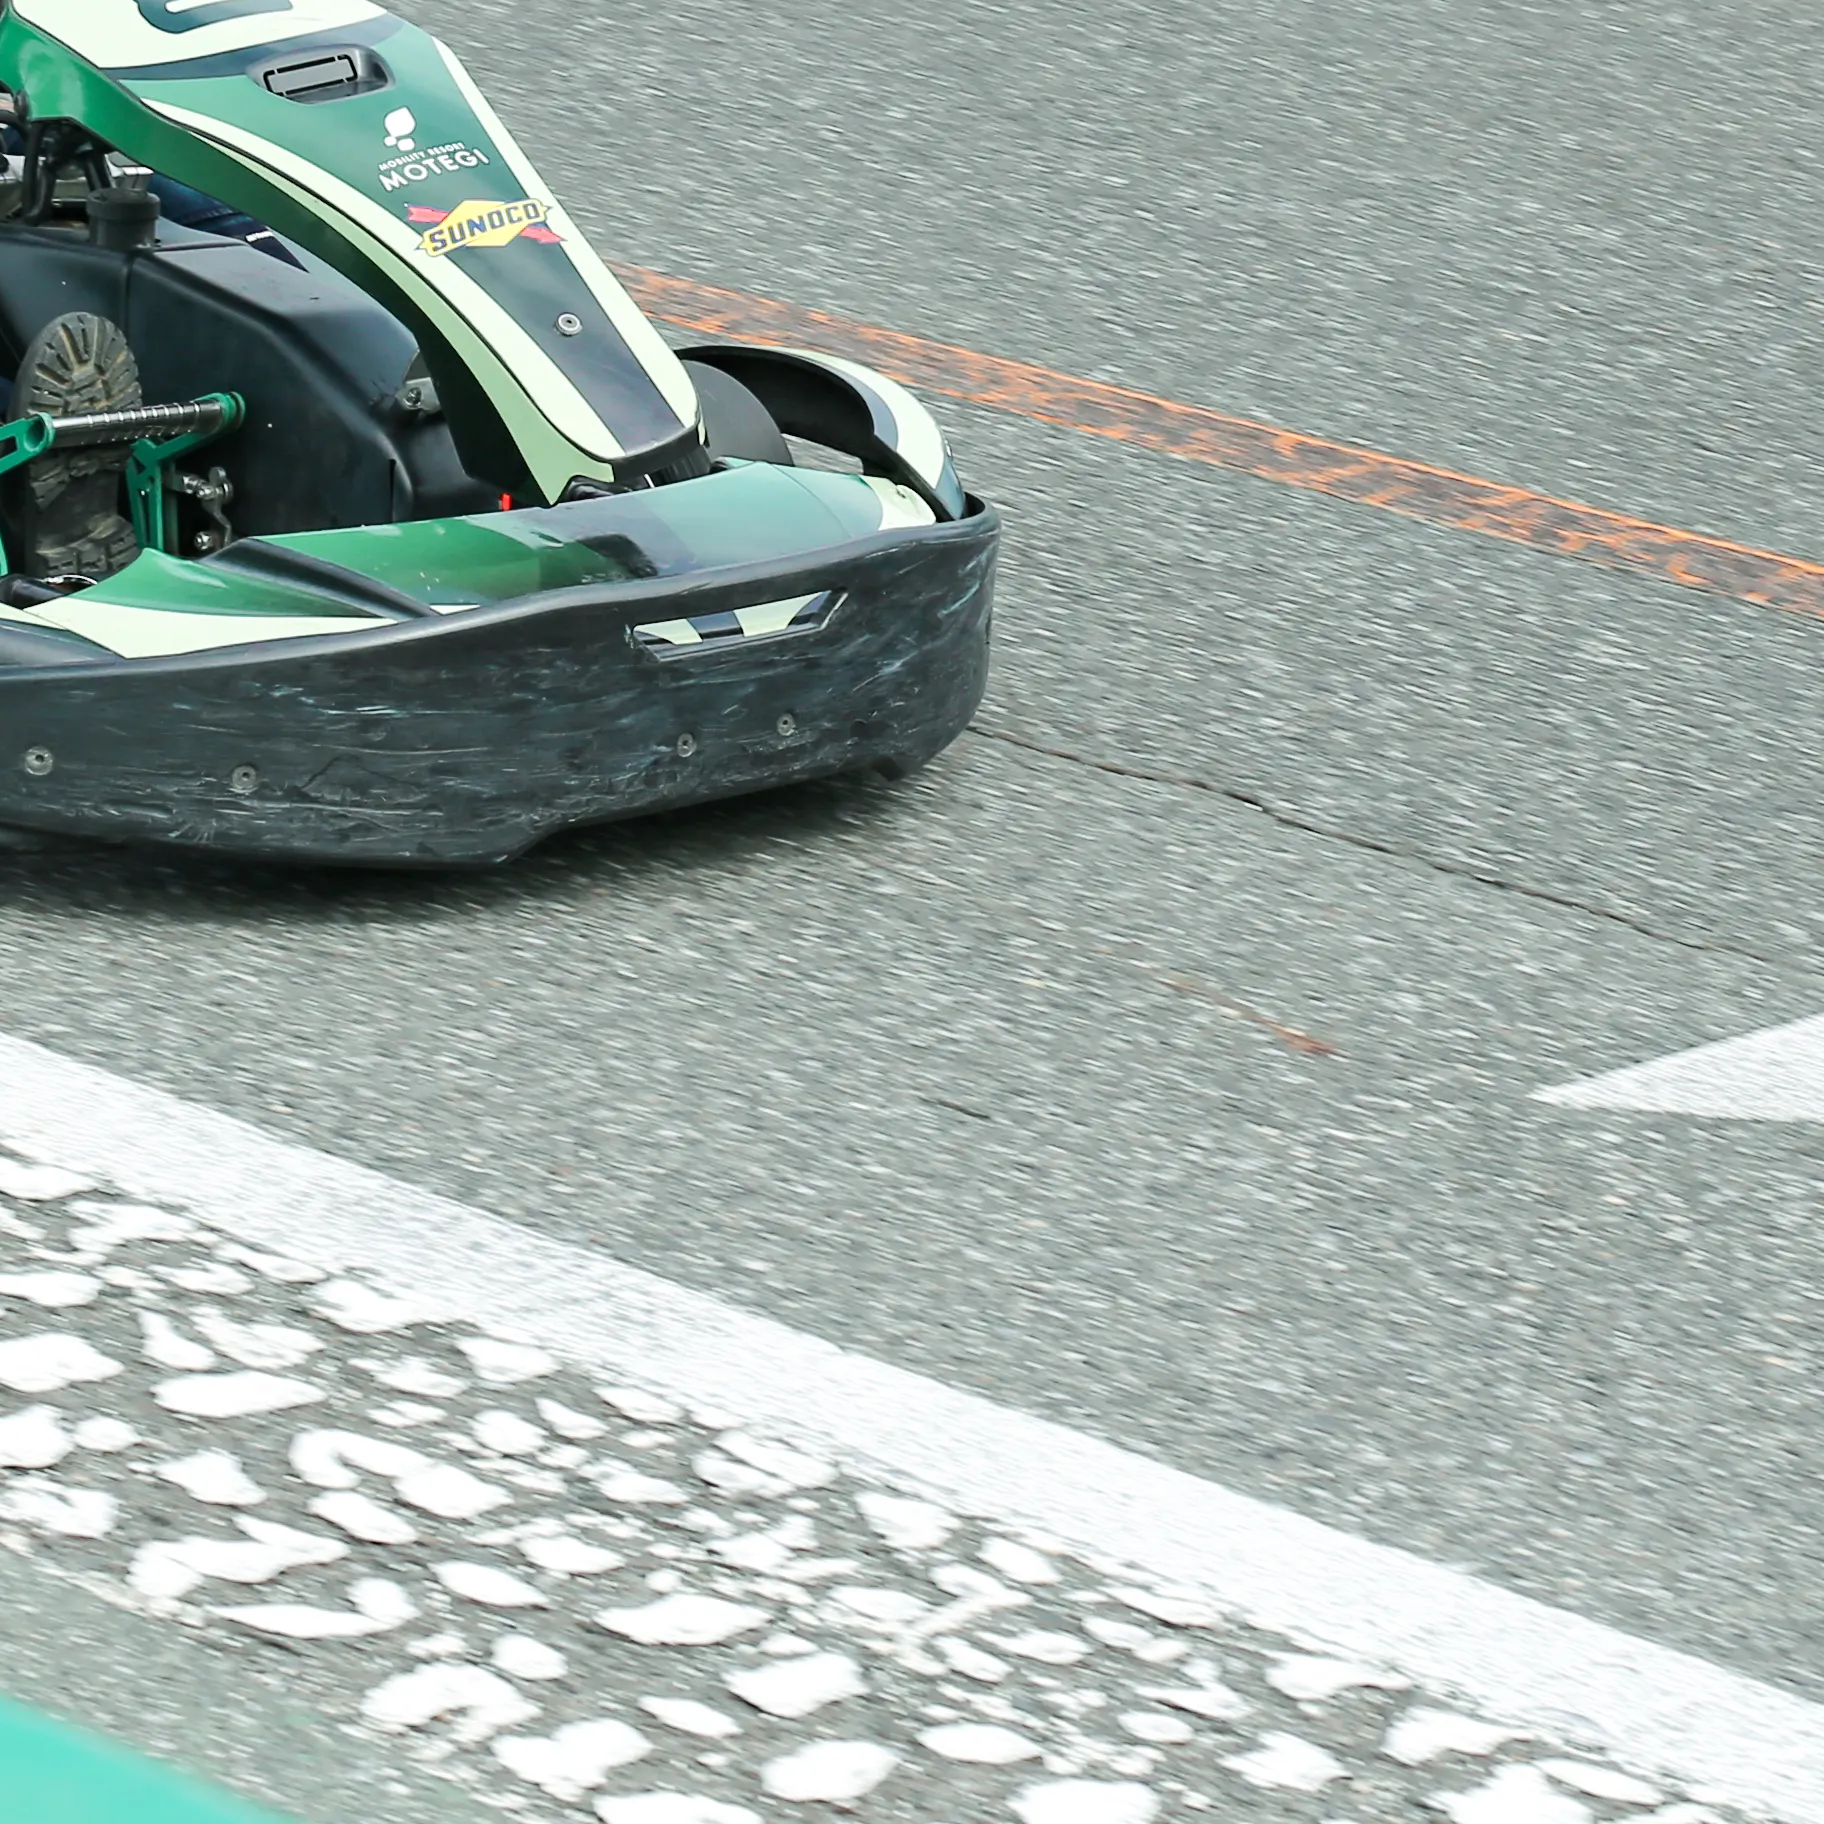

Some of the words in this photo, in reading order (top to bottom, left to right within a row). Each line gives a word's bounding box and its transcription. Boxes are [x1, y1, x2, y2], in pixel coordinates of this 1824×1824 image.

[378, 149, 427, 171] MOBILITY
[427, 142, 465, 157] RESORT
[378, 148, 490, 192] MOTEGI
[428, 202, 541, 252] SUNOCO
